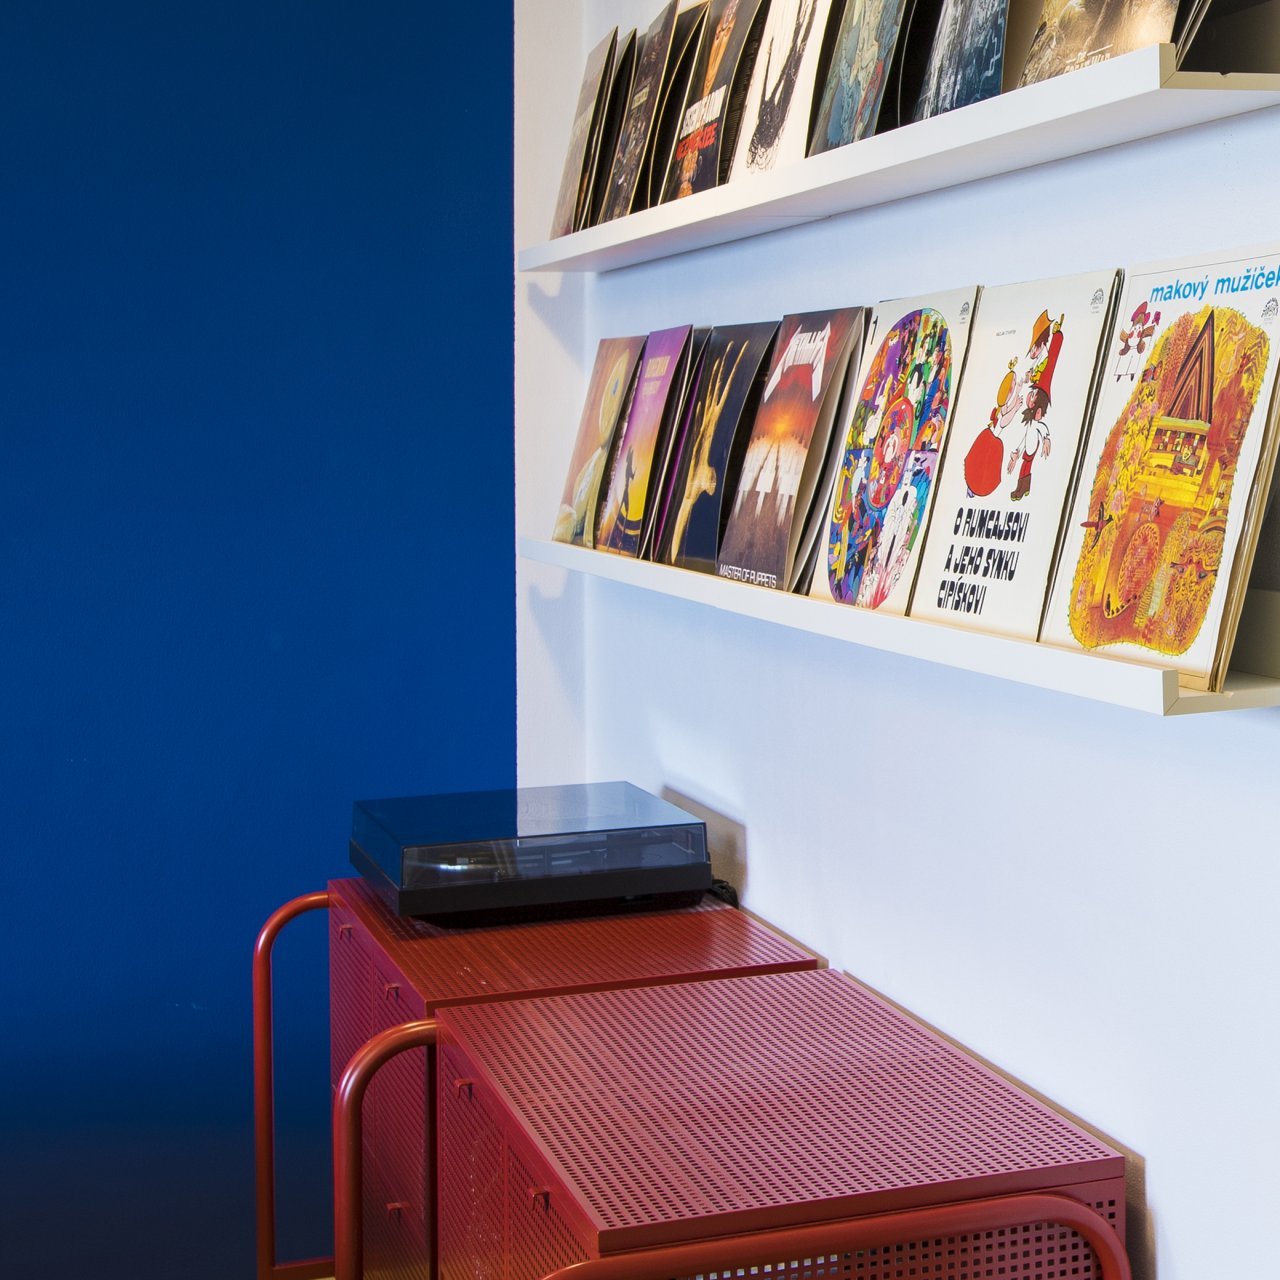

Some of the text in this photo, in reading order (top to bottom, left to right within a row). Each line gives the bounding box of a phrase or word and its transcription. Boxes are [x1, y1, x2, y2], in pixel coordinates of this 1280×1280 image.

[1149, 275, 1209, 302] makový
[953, 507, 1030, 542] O RUMCAJSOVI
[719, 564, 777, 589] MASTER OF PUPPETS
[943, 544, 1020, 581] A JEHO SYNKU
[937, 575, 988, 615] CIPÍSKOVI
